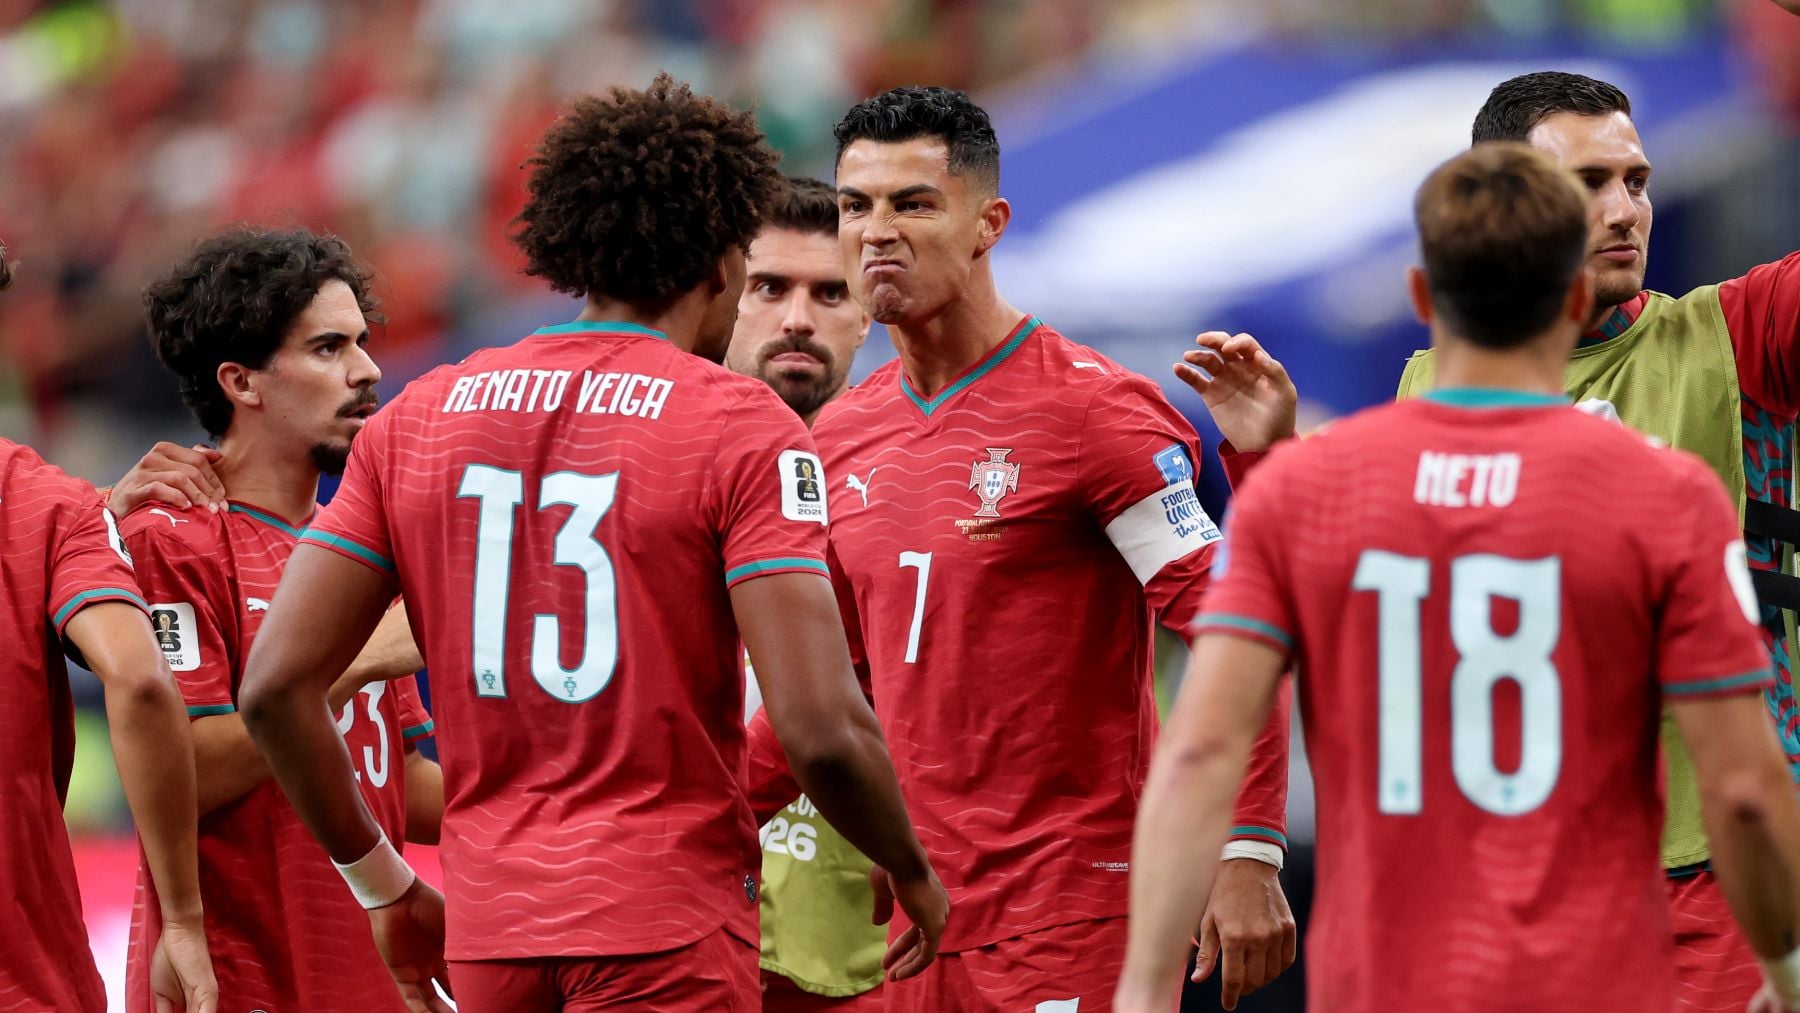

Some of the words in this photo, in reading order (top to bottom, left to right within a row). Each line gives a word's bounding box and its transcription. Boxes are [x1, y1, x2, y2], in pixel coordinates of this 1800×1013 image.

[442, 369, 573, 413] RENATO
[576, 370, 675, 420] VEIGA
[1161, 488, 1197, 509] FOOTBA
[1413, 449, 1522, 508] NETO
[969, 533, 1000, 541] HOUSTON
[1173, 524, 1198, 538] the
[456, 463, 620, 704] 13
[898, 550, 933, 664] 7
[1353, 550, 1562, 816] 18
